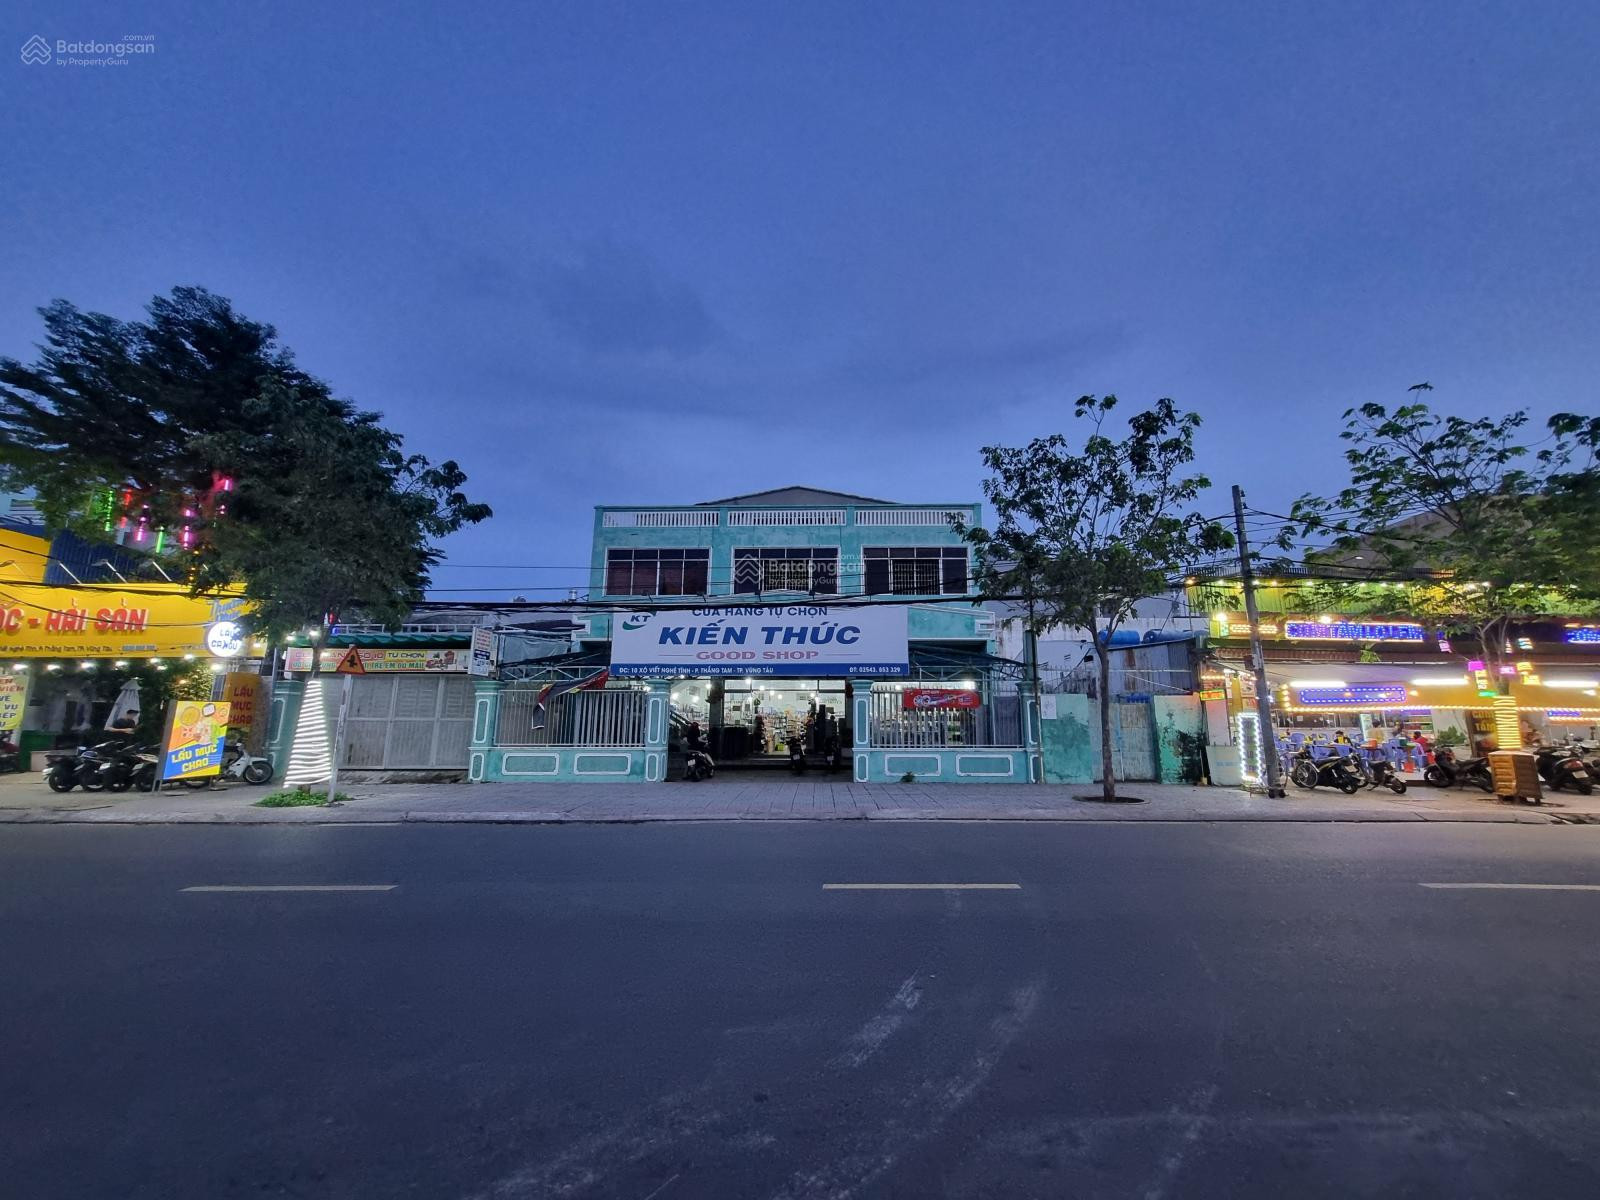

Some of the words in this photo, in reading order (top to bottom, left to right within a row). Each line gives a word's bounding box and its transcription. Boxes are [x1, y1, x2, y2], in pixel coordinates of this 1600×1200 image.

[658, 619, 748, 645] KIẾN
[760, 621, 861, 645] THỨC
[696, 651, 756, 660] GOOD
[762, 651, 819, 660] SHOP
